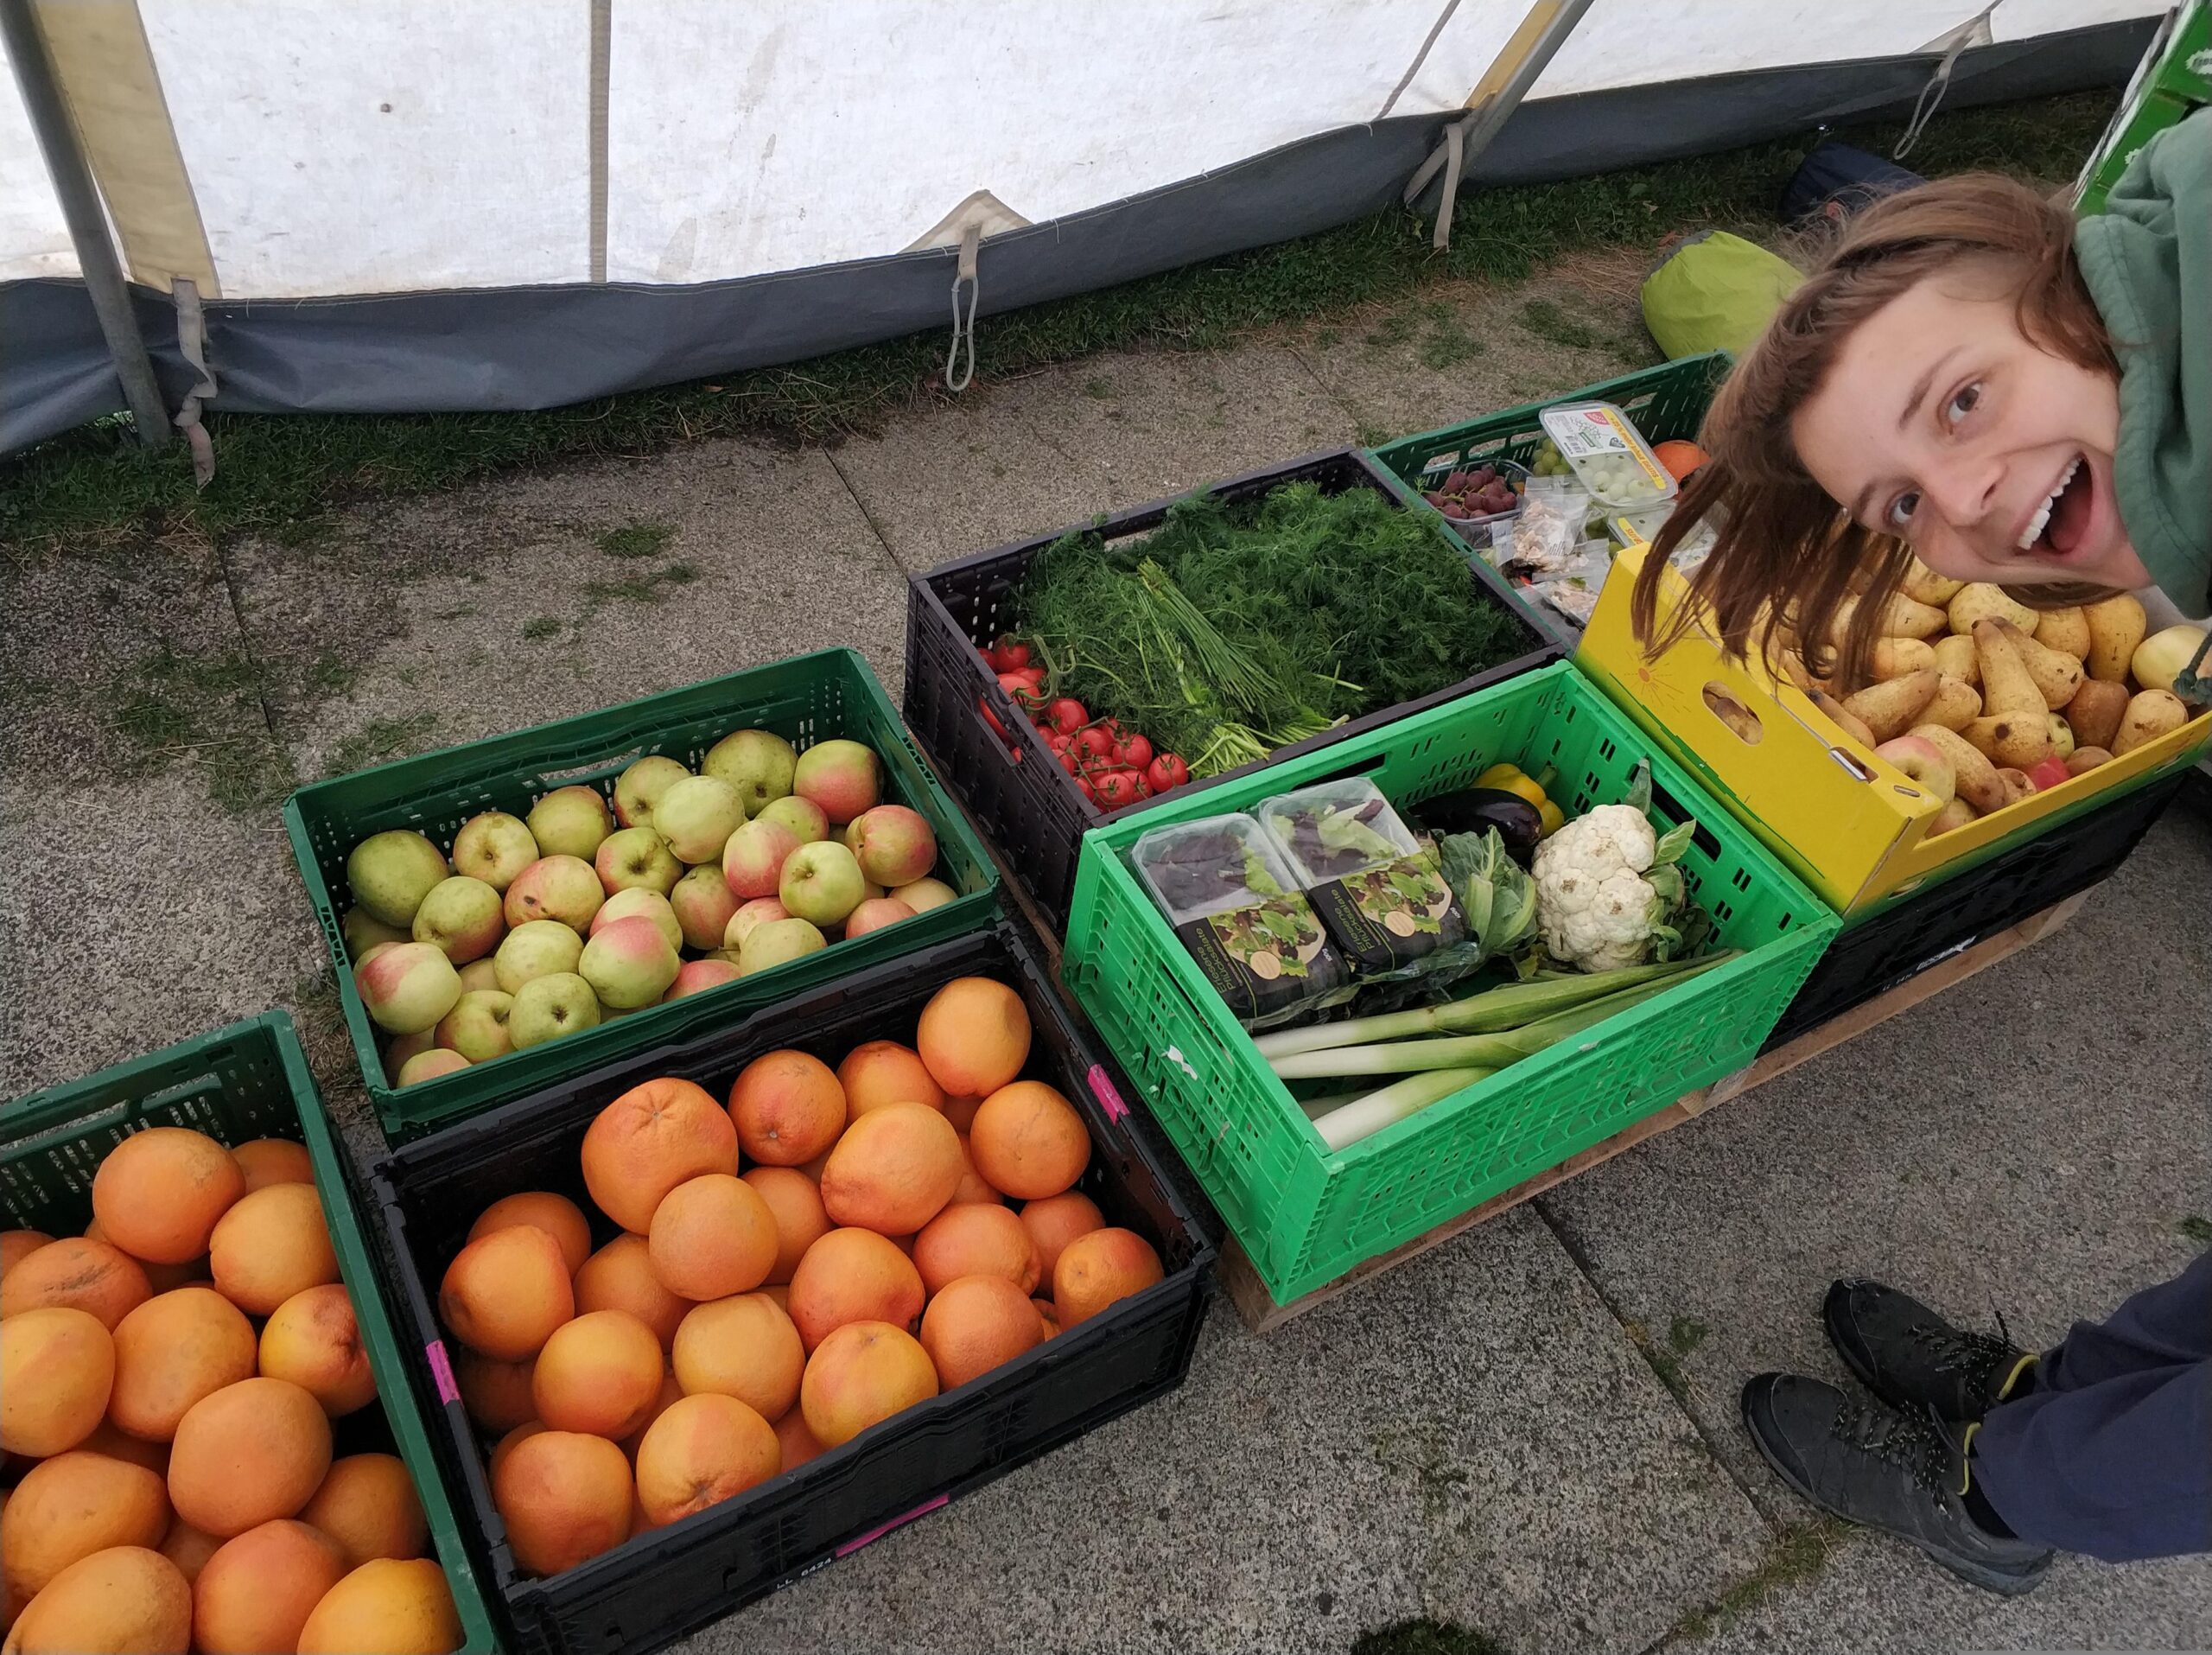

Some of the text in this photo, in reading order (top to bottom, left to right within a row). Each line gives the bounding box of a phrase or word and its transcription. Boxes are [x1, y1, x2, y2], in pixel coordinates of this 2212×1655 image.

[1641, 461, 1658, 477] GRATIS
[1331, 889, 1376, 950] Pflücksalate
[1335, 907, 1367, 952] Erlesene
[1196, 927, 1236, 991] Pflücksalate
[1198, 946, 1227, 994] Erlesene
